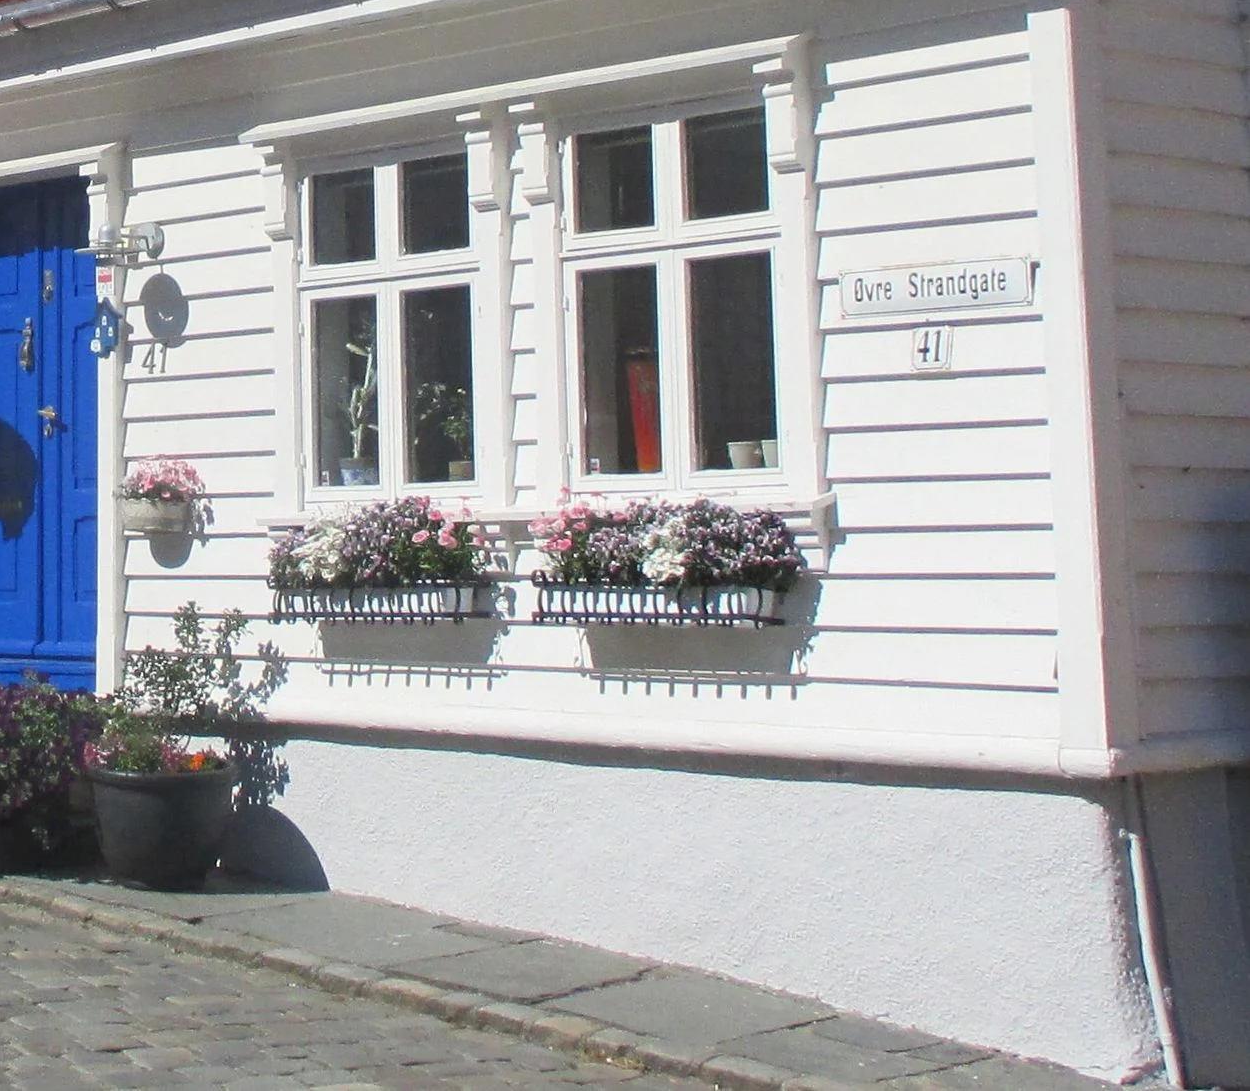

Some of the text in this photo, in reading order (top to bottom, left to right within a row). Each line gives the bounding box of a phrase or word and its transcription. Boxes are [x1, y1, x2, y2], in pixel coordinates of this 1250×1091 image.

[854, 268, 1007, 302] Øvre Strandgate
[141, 342, 167, 374] 41
[916, 329, 942, 363] 41
